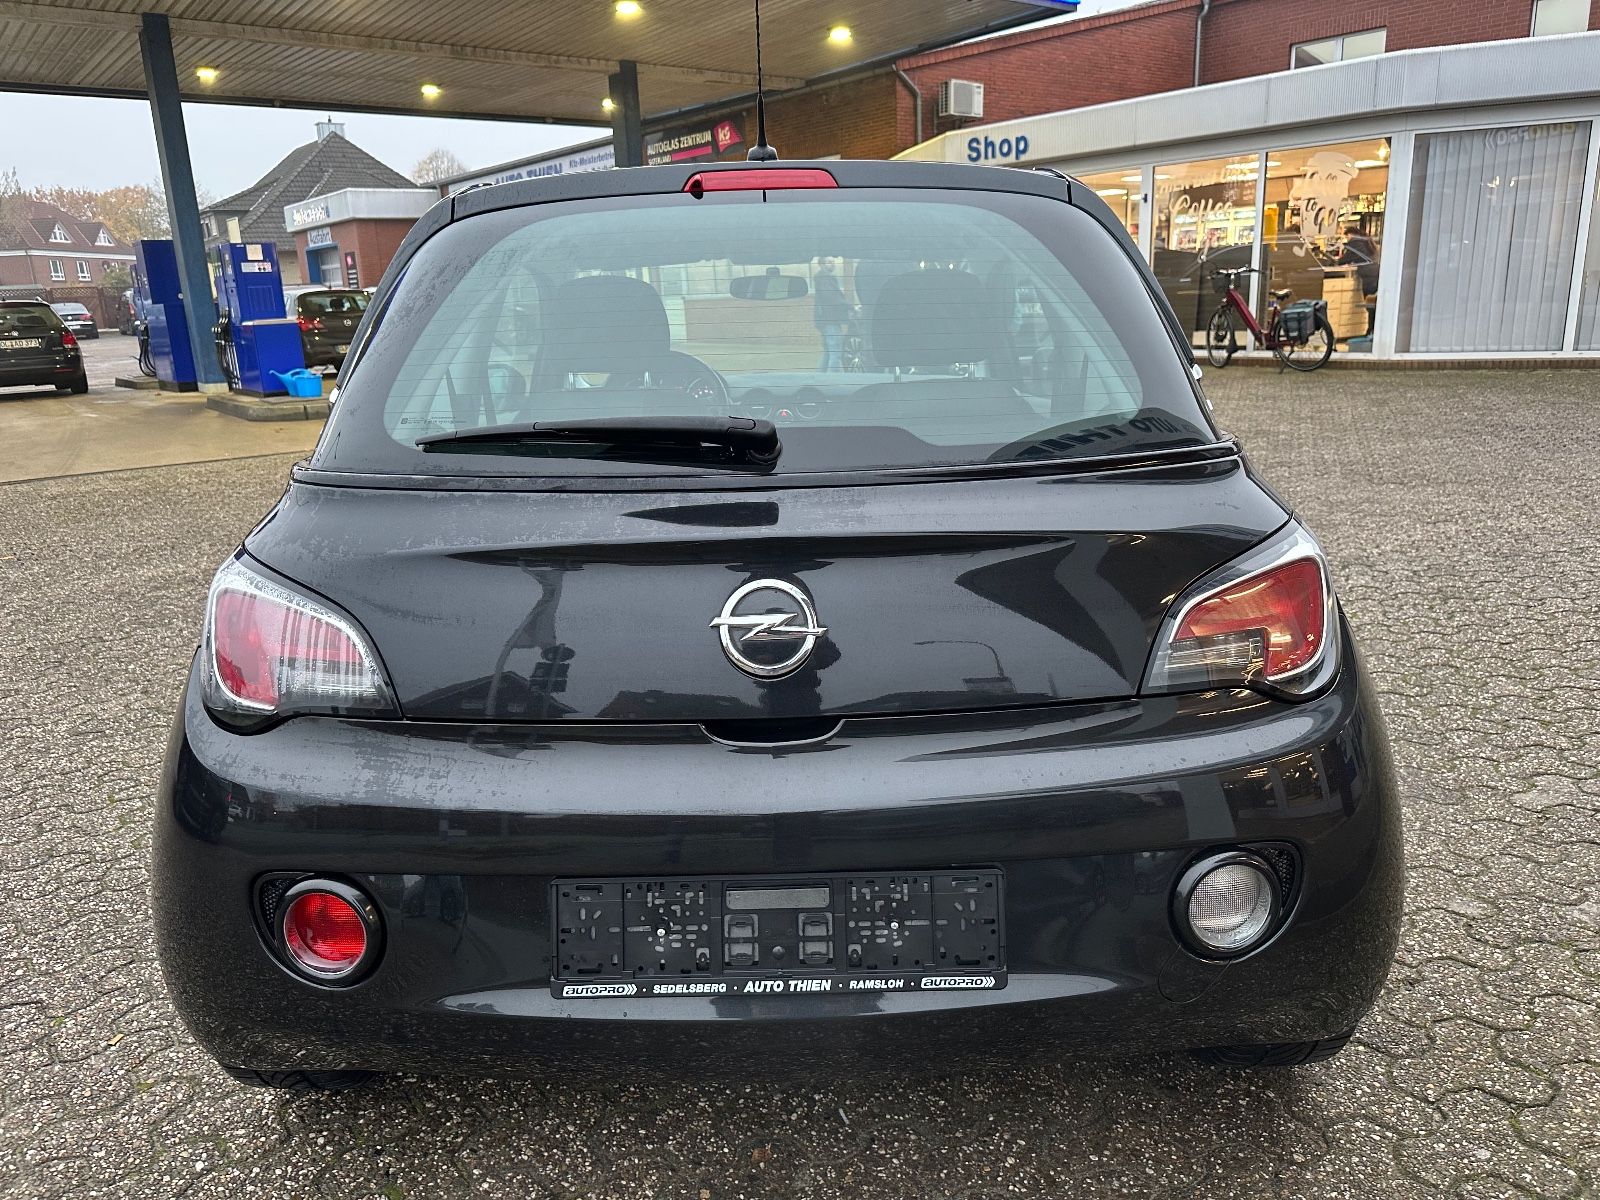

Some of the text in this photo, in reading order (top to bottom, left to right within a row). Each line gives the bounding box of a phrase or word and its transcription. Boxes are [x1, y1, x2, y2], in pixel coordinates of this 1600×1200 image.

[646, 130, 712, 156] AUTOGLAS ZENTRUM
[967, 134, 1028, 163] Shop
[652, 983, 728, 995] SEDELSBERG
[743, 979, 786, 994] AUTO
[788, 977, 832, 992] THIEN
[848, 978, 905, 990] RAMSLOH
